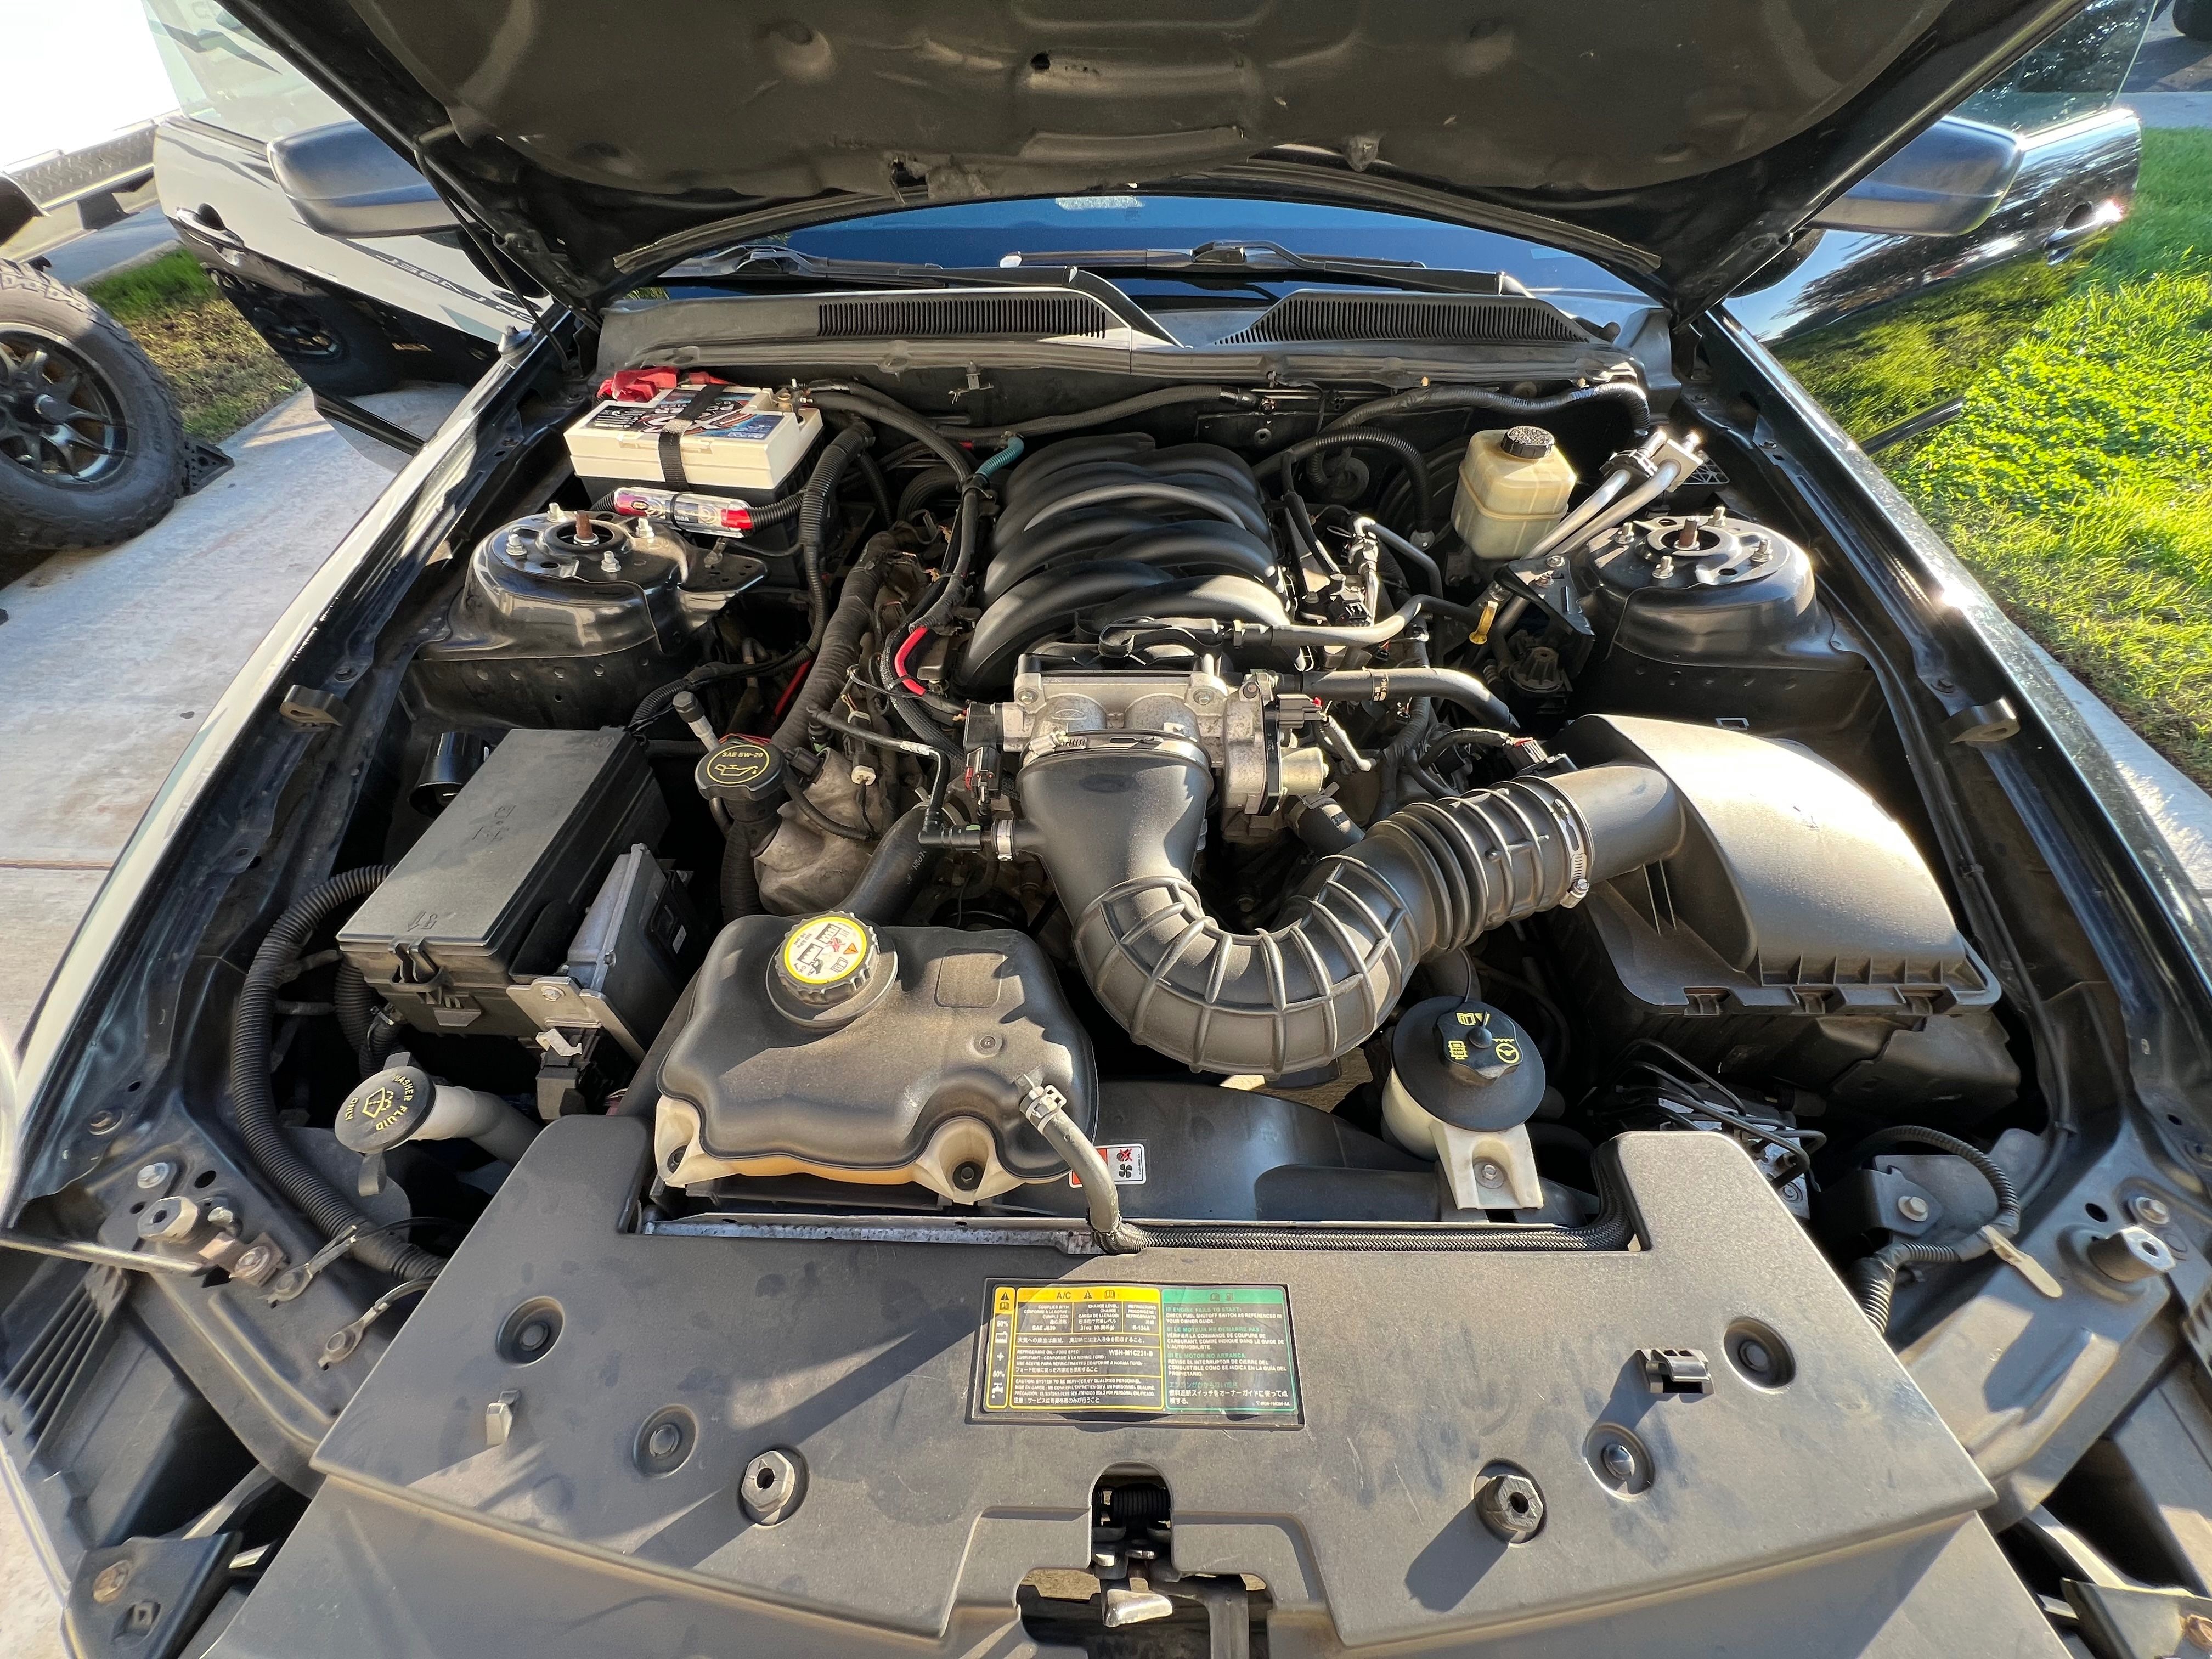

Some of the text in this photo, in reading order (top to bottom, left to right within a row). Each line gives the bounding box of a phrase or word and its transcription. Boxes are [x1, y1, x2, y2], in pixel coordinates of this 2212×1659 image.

[345, 1097, 359, 1121] ONLY
[376, 1074, 415, 1131] WASHER FLUID
[1056, 1291, 1071, 1300] A/C
